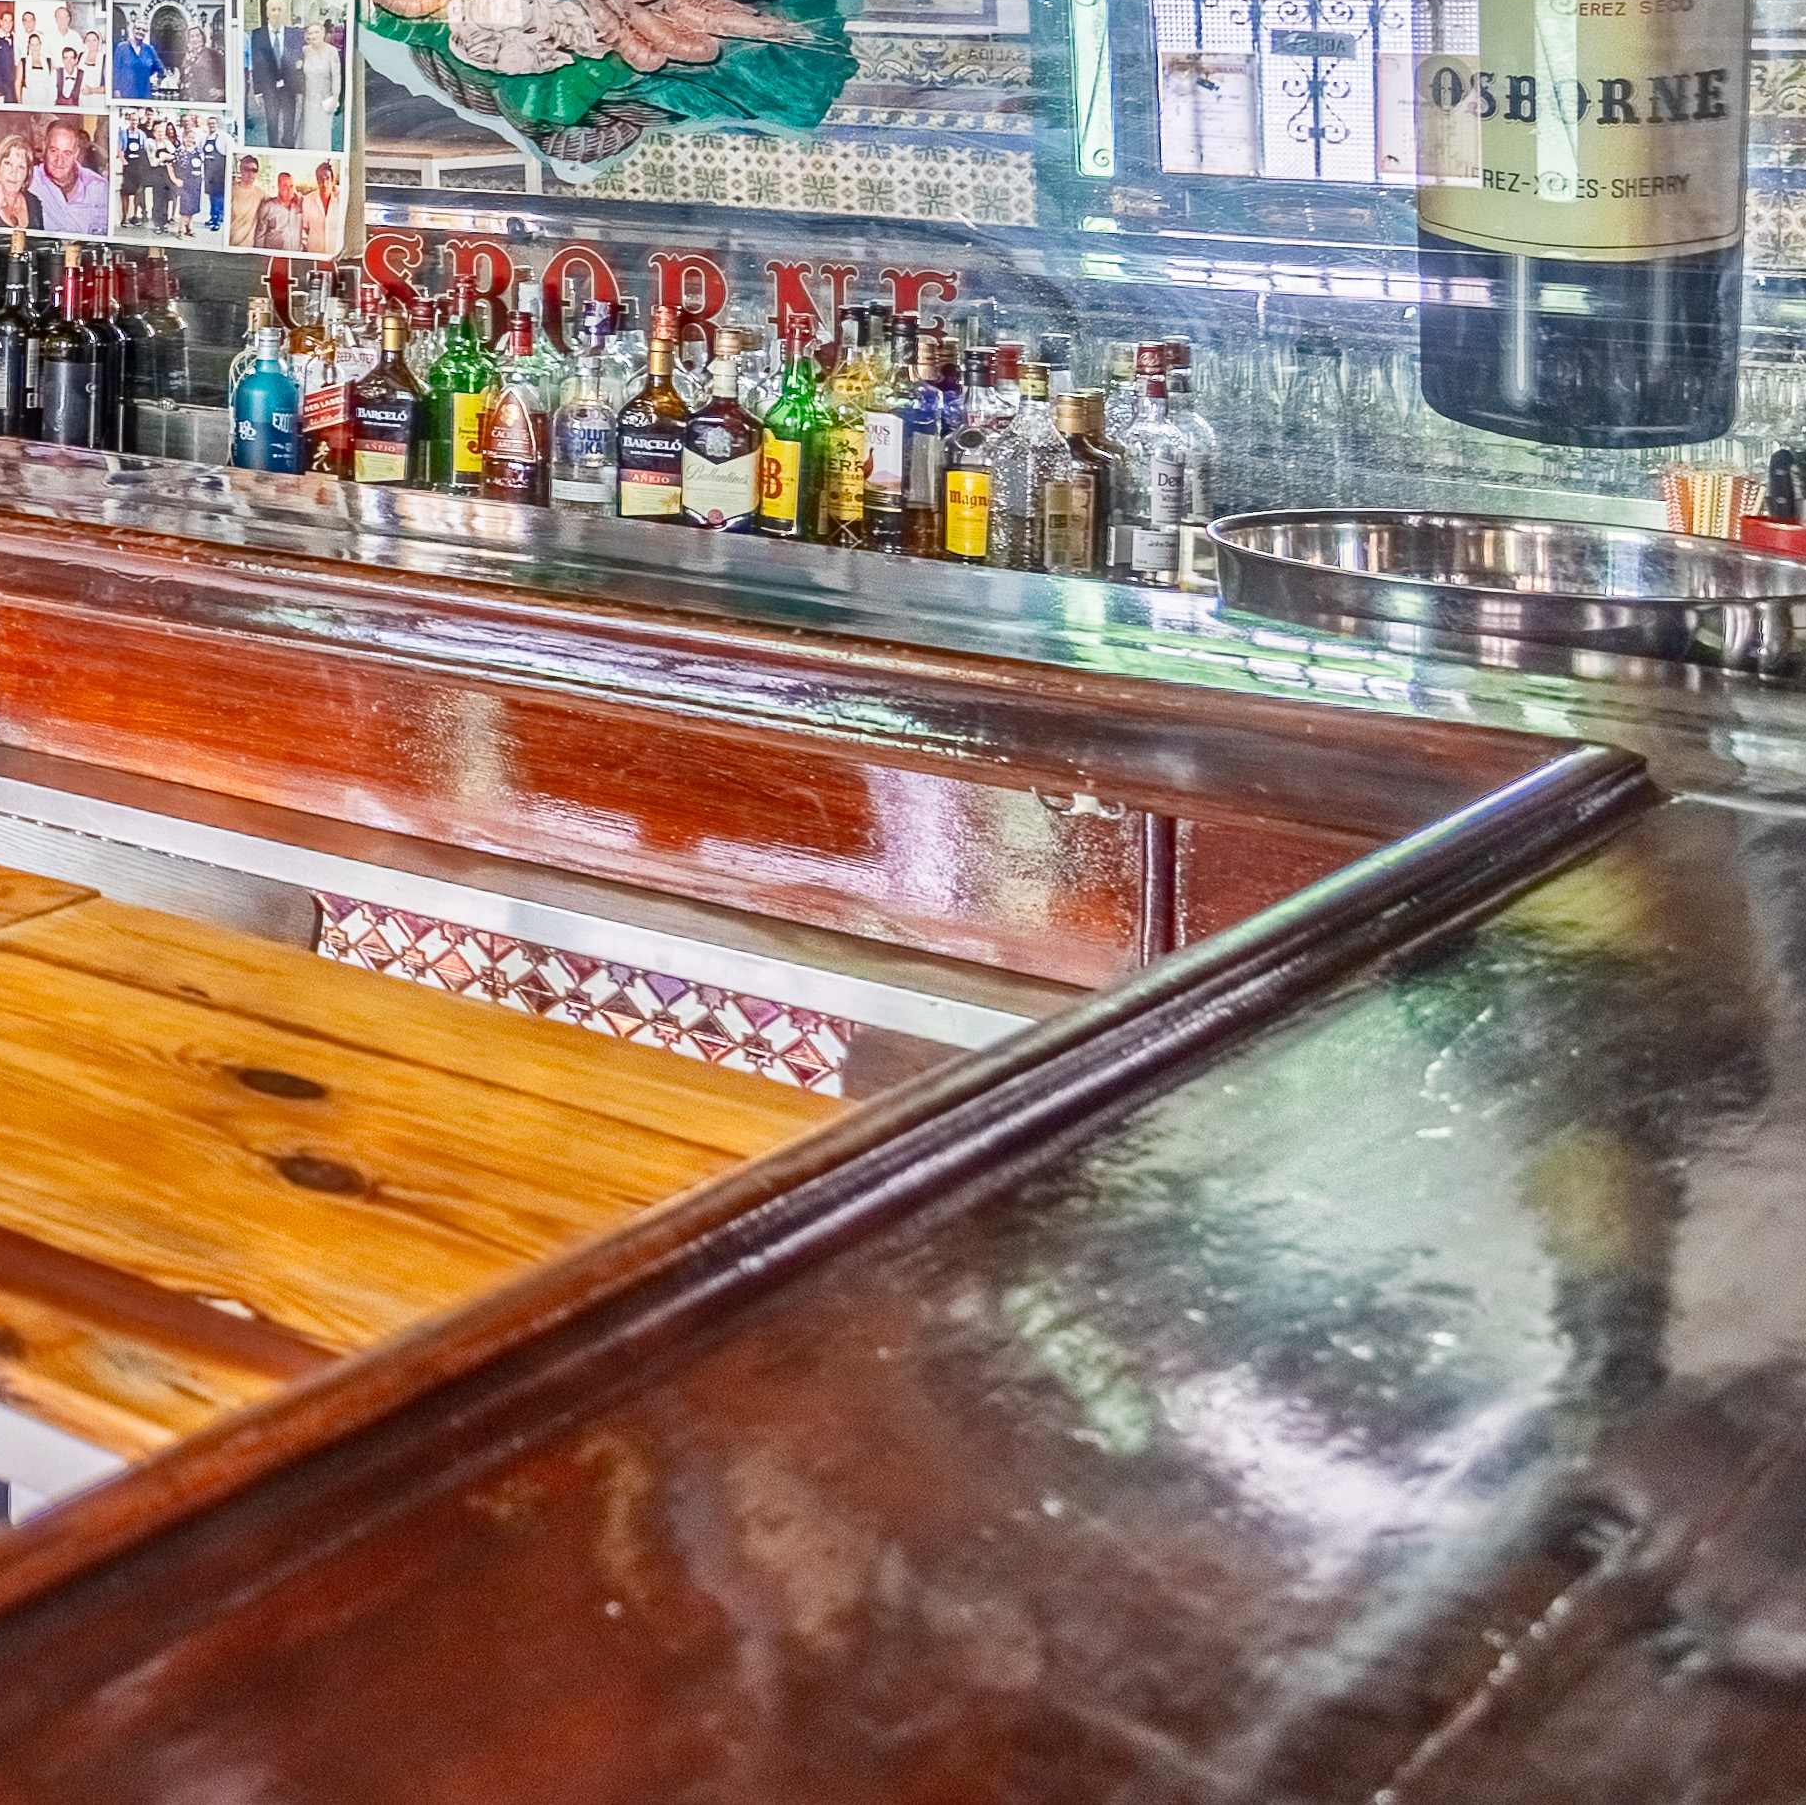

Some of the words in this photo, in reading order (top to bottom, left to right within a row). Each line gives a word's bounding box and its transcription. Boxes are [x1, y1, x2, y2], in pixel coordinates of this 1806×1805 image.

[1578, 1, 1627, 17] EREZ
[1431, 66, 1729, 127] OSBORNE
[264, 231, 960, 366] OSBORNE
[336, 350, 375, 365] BEEFTER
[303, 402, 320, 413] RED
[320, 396, 346, 409] LABEL
[356, 406, 409, 423] BARCELÓ
[568, 427, 611, 441] SOLUT
[865, 423, 891, 436] OUS
[623, 435, 683, 452] BARCELÓ
[865, 434, 891, 446] USE
[631, 472, 671, 484] AÑEJO
[685, 460, 749, 486] Ballantine's
[948, 489, 988, 509] Magn
